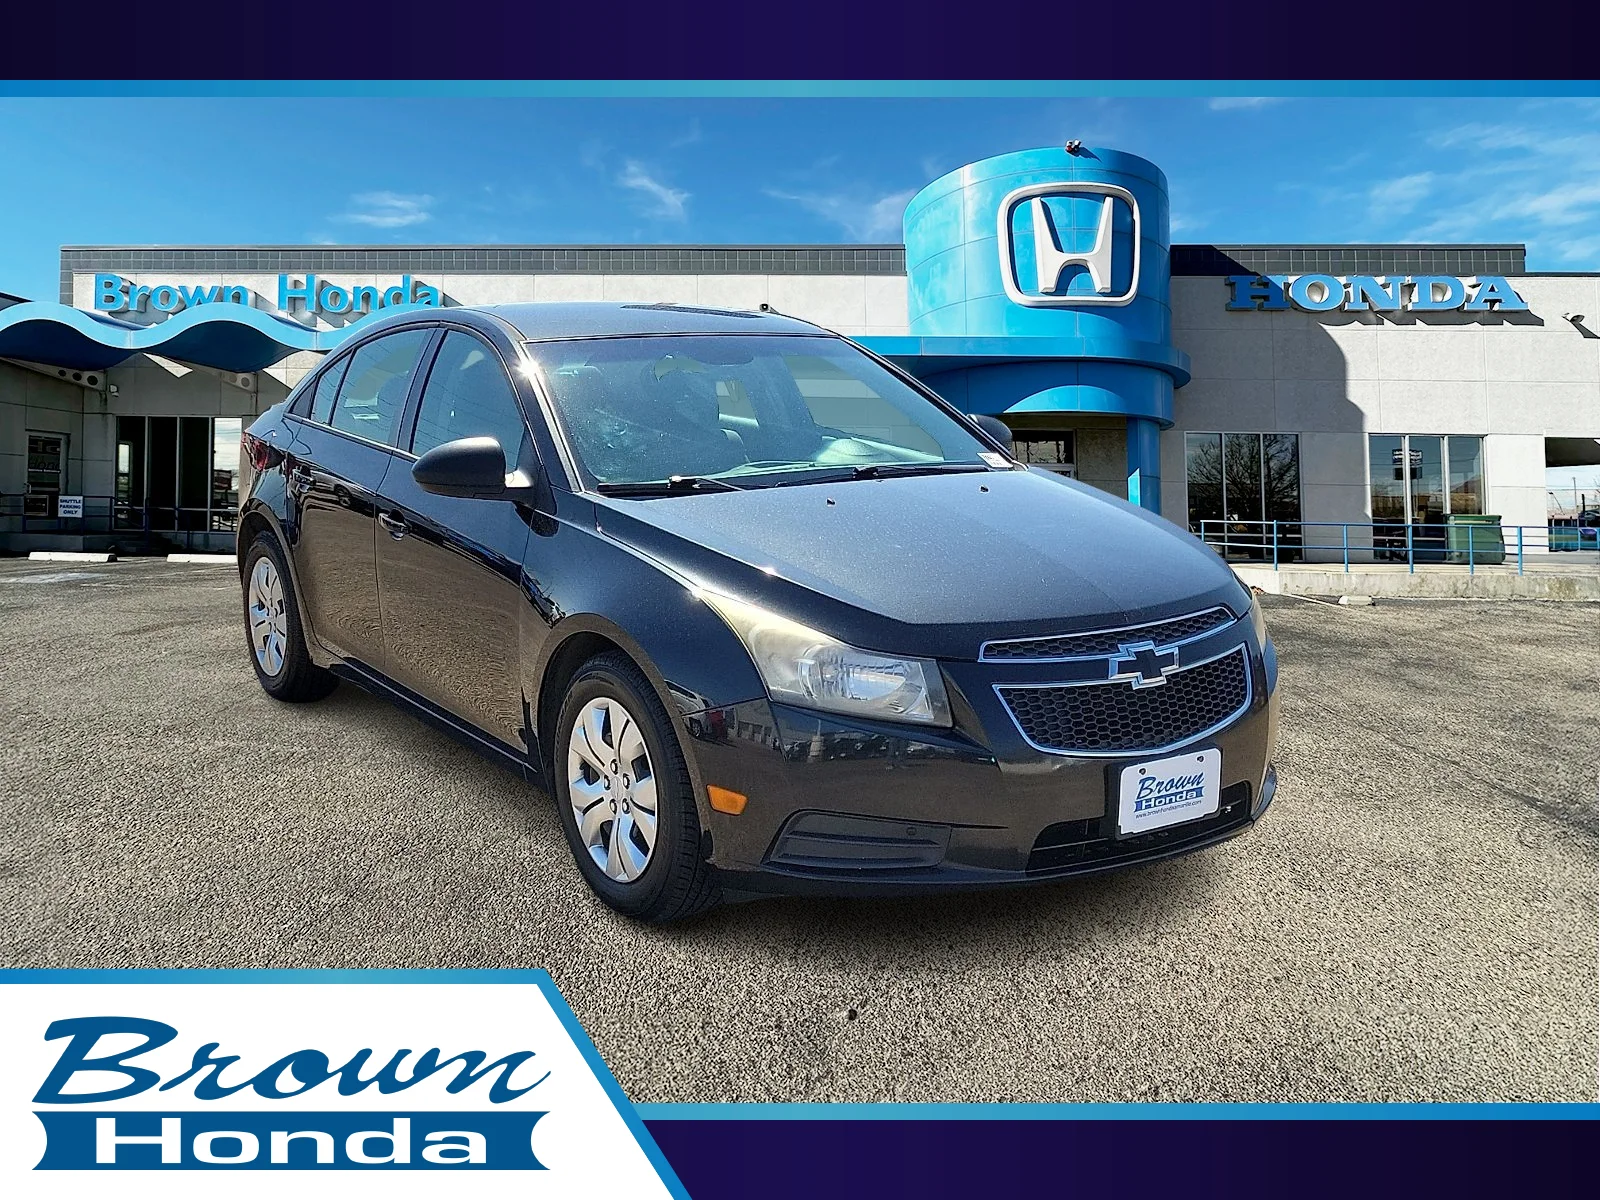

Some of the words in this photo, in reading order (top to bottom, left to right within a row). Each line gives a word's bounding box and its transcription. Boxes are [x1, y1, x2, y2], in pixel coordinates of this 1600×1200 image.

[94, 273, 250, 312] Brown
[278, 274, 440, 313] Honda
[1226, 273, 1529, 311] HONDA
[1136, 772, 1205, 800] Brown
[1141, 790, 1197, 810] Honda
